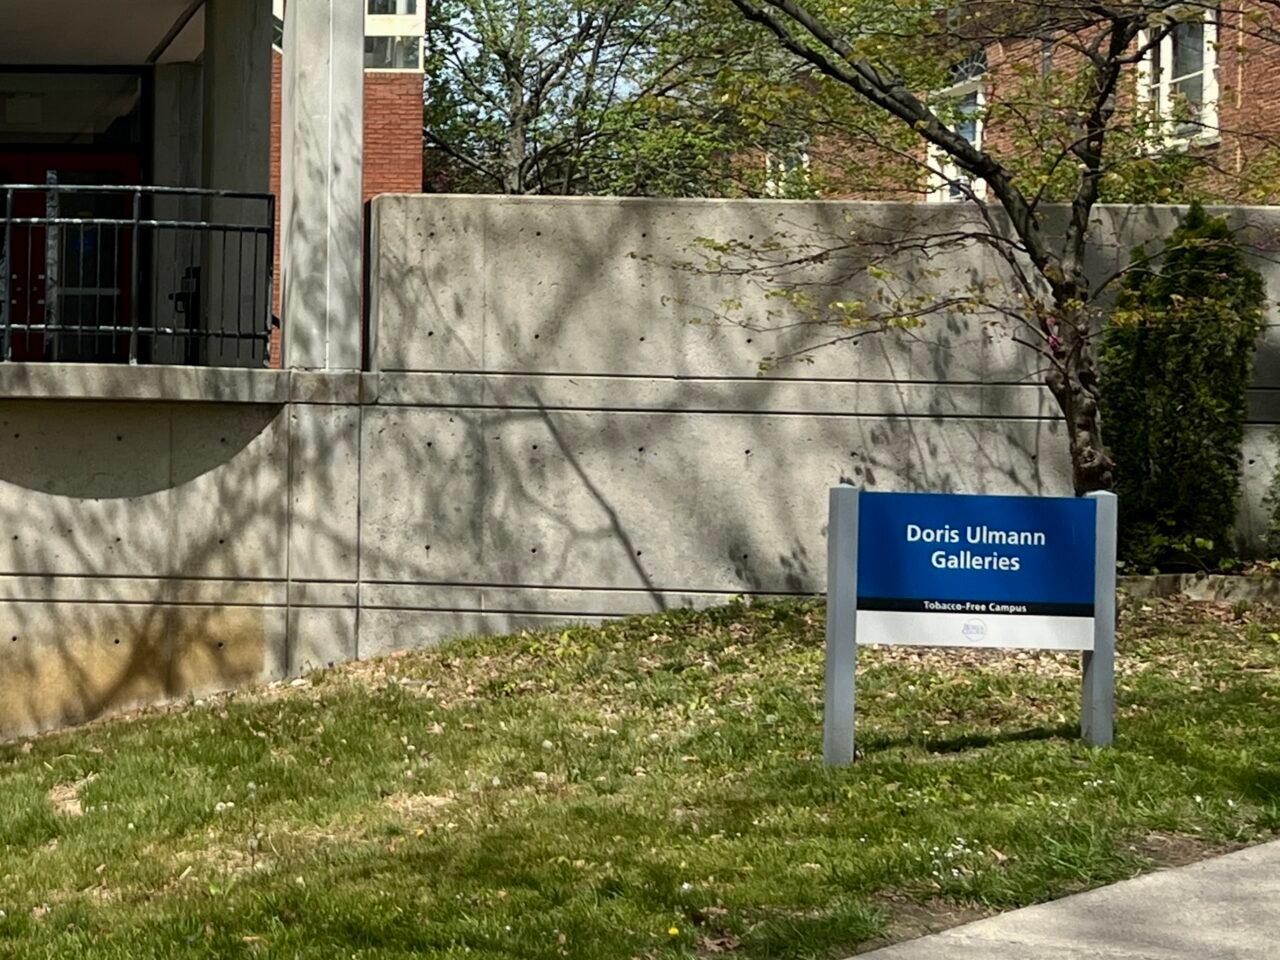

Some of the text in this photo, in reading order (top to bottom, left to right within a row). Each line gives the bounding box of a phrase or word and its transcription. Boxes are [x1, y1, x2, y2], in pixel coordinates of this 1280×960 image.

[906, 524, 1046, 546] Doris Ulmann
[931, 550, 1021, 571] Galleries
[923, 600, 1027, 614] Tobacco-Free Campus
